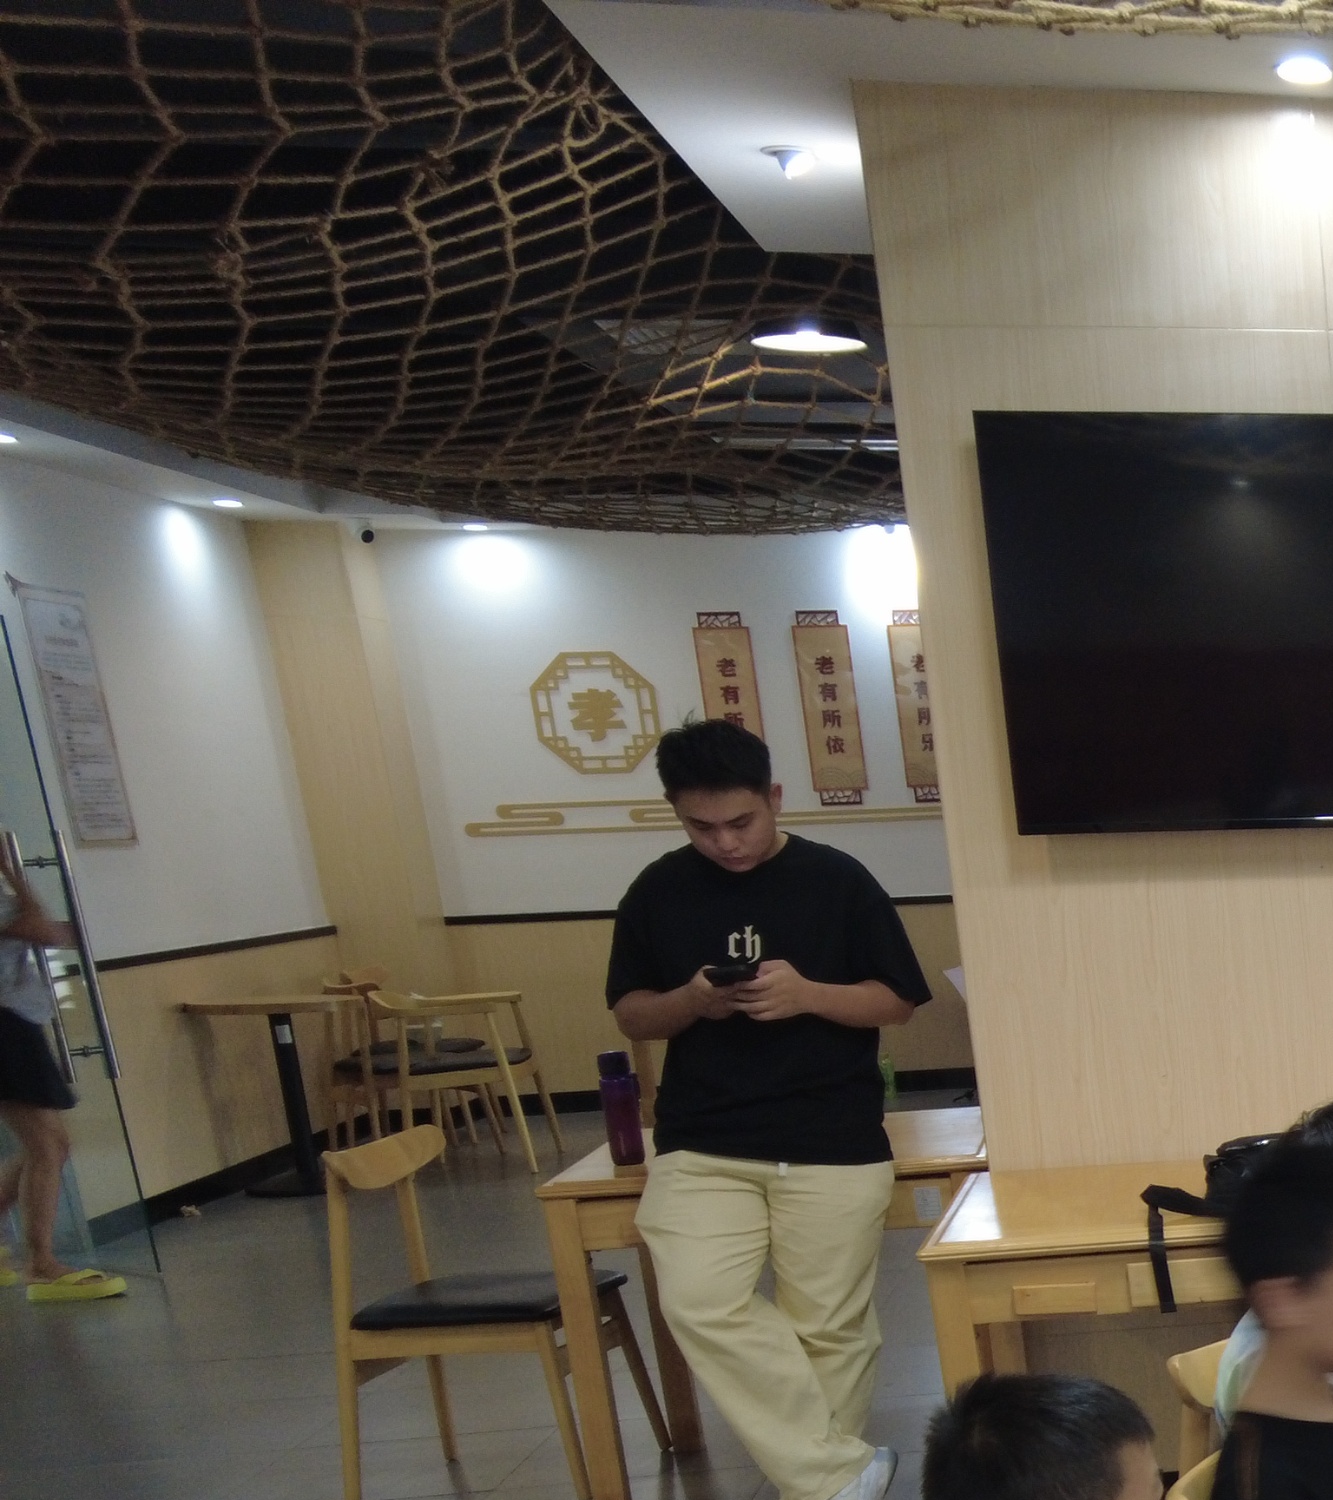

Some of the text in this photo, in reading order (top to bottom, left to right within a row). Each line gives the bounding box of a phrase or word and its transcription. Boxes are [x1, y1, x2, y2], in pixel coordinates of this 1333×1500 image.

[567, 688, 627, 742] 孝
[814, 655, 846, 755] 老有所依
